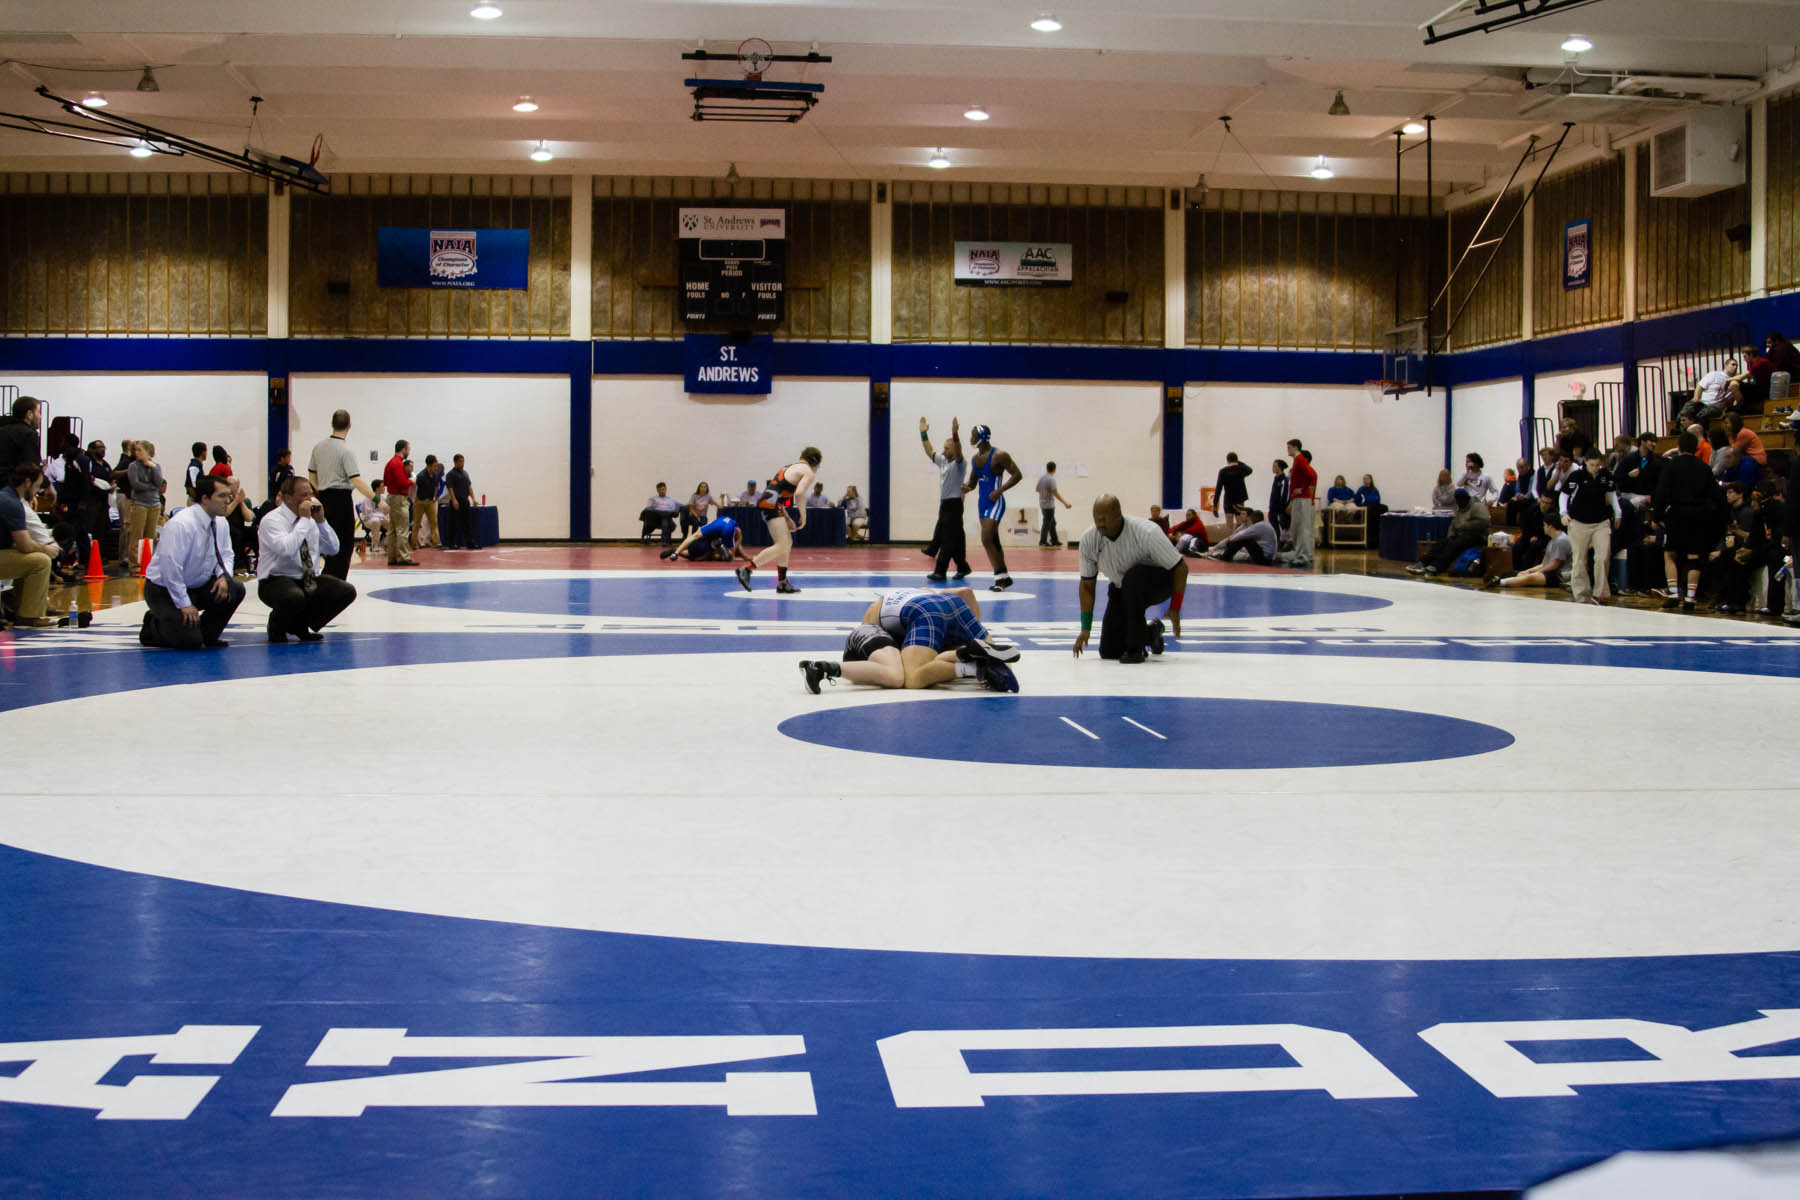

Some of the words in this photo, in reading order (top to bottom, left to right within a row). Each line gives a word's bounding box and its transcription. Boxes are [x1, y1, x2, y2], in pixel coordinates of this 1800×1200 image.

[718, 215, 756, 225] Andrews
[433, 240, 473, 254] NAIA
[1025, 247, 1053, 259] AAC
[970, 249, 999, 260] NAIA
[686, 282, 709, 291] HOME
[751, 282, 782, 291] VISITOR
[720, 346, 738, 361] ST.
[698, 367, 759, 383] ANDREWS
[1017, 508, 1028, 524] 1
